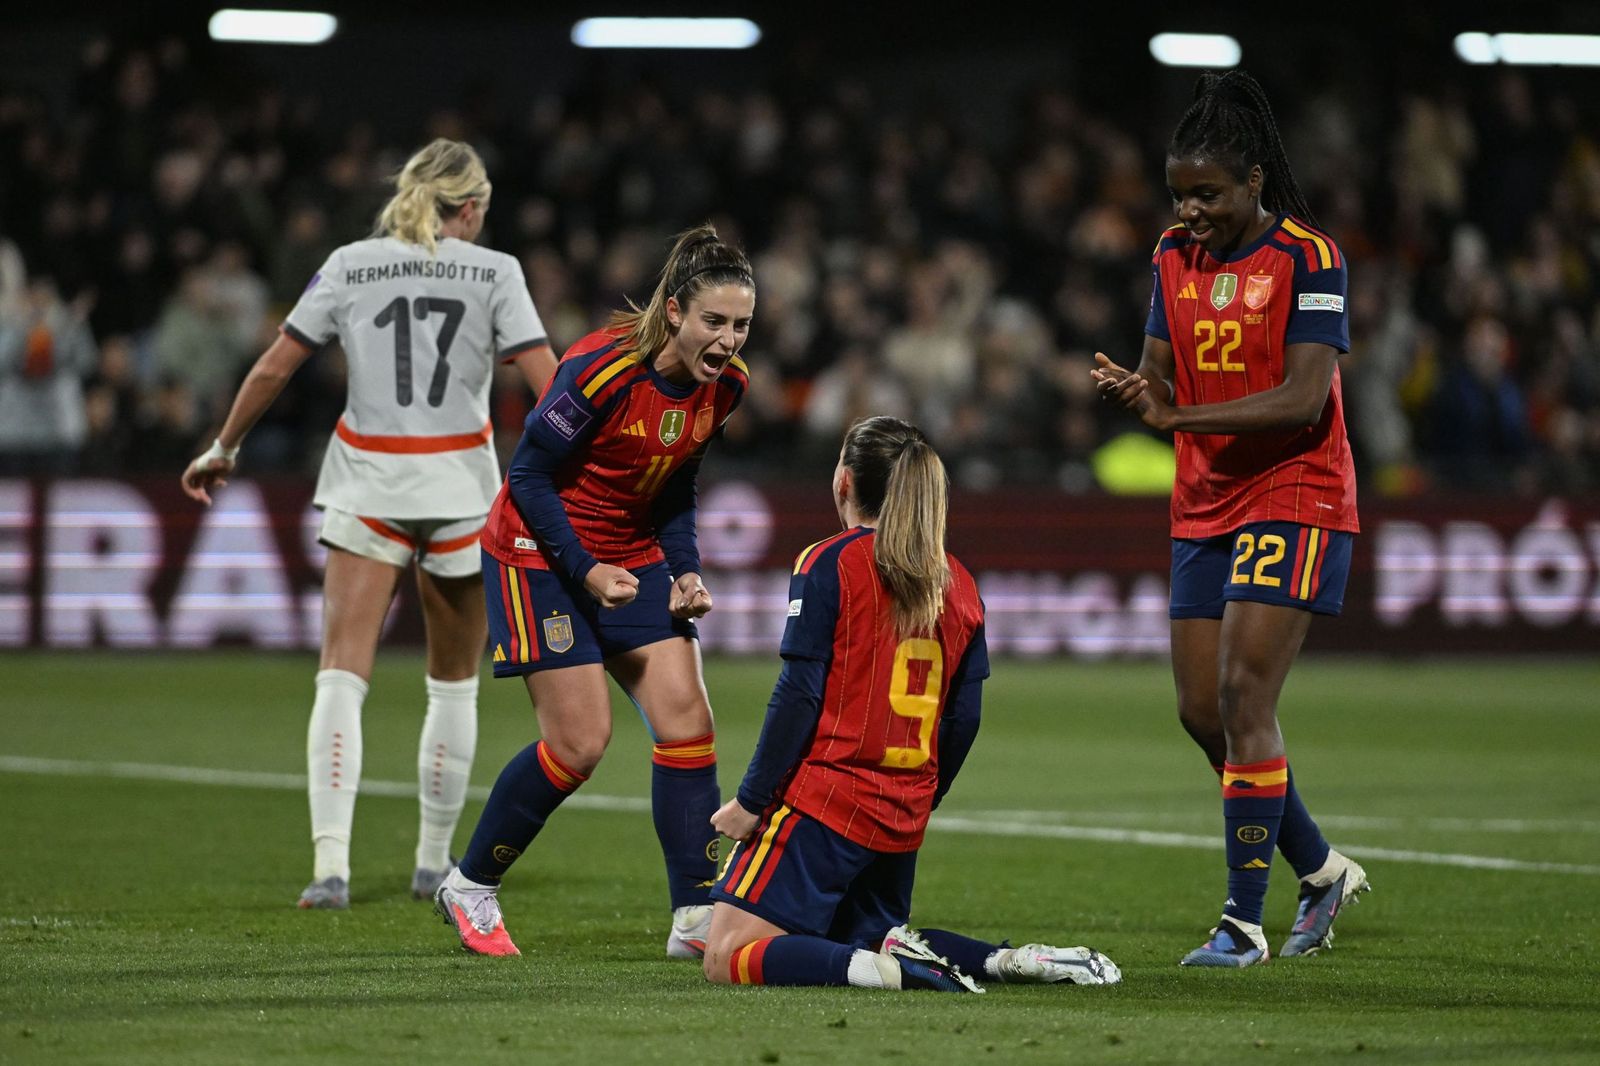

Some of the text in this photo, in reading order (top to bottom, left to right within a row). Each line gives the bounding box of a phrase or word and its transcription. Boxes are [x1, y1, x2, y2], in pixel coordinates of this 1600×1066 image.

[346, 260, 497, 285] HERMANNSDÓTTIR
[1299, 298, 1343, 306] FOUNDATION
[374, 296, 466, 408] 17
[1194, 320, 1245, 371] 22
[547, 412, 572, 435] QUALIFIERS
[550, 409, 574, 432] EUROPEAN
[634, 455, 674, 494] 11
[1231, 533, 1286, 587] 22
[1374, 498, 1600, 628] PRÓ
[880, 638, 943, 769] 9
